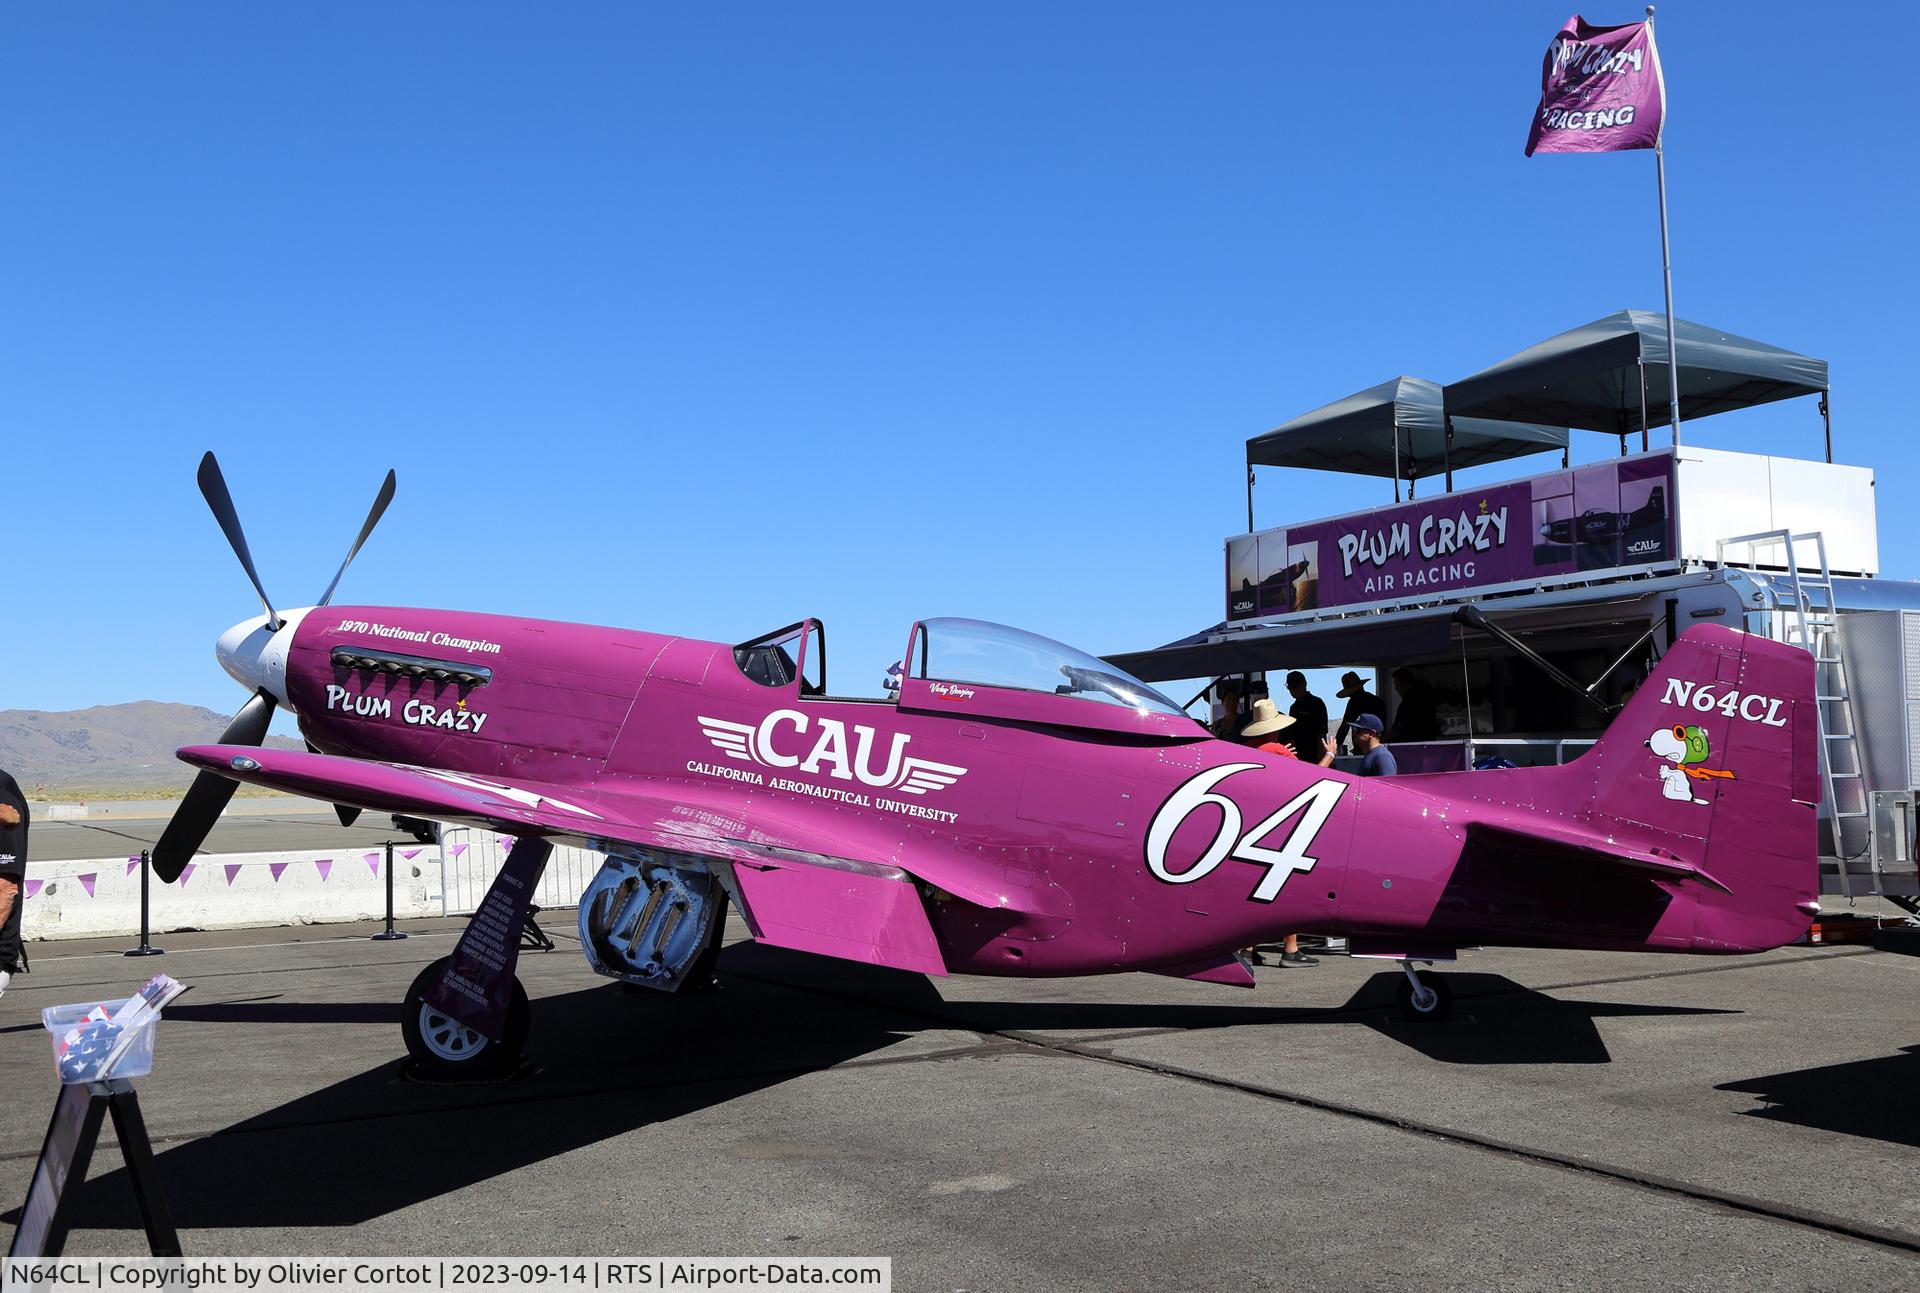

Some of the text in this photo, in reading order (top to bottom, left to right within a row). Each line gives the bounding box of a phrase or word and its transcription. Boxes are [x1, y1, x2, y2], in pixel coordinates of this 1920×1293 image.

[1547, 106, 1634, 129] RACING
[1337, 507, 1508, 577] PLUM CRAZY
[1634, 540, 1654, 551] CAU
[1365, 562, 1475, 592] AIR RACING
[337, 619, 501, 654] 1970 National Champion
[326, 684, 488, 733] PLUM CRAZY
[1660, 677, 1788, 728] N64CL
[757, 709, 911, 788] CAU
[686, 760, 958, 824] CALIFORNIA AERONAUTICAL UNIVERSITY
[1144, 762, 1349, 904] 64
